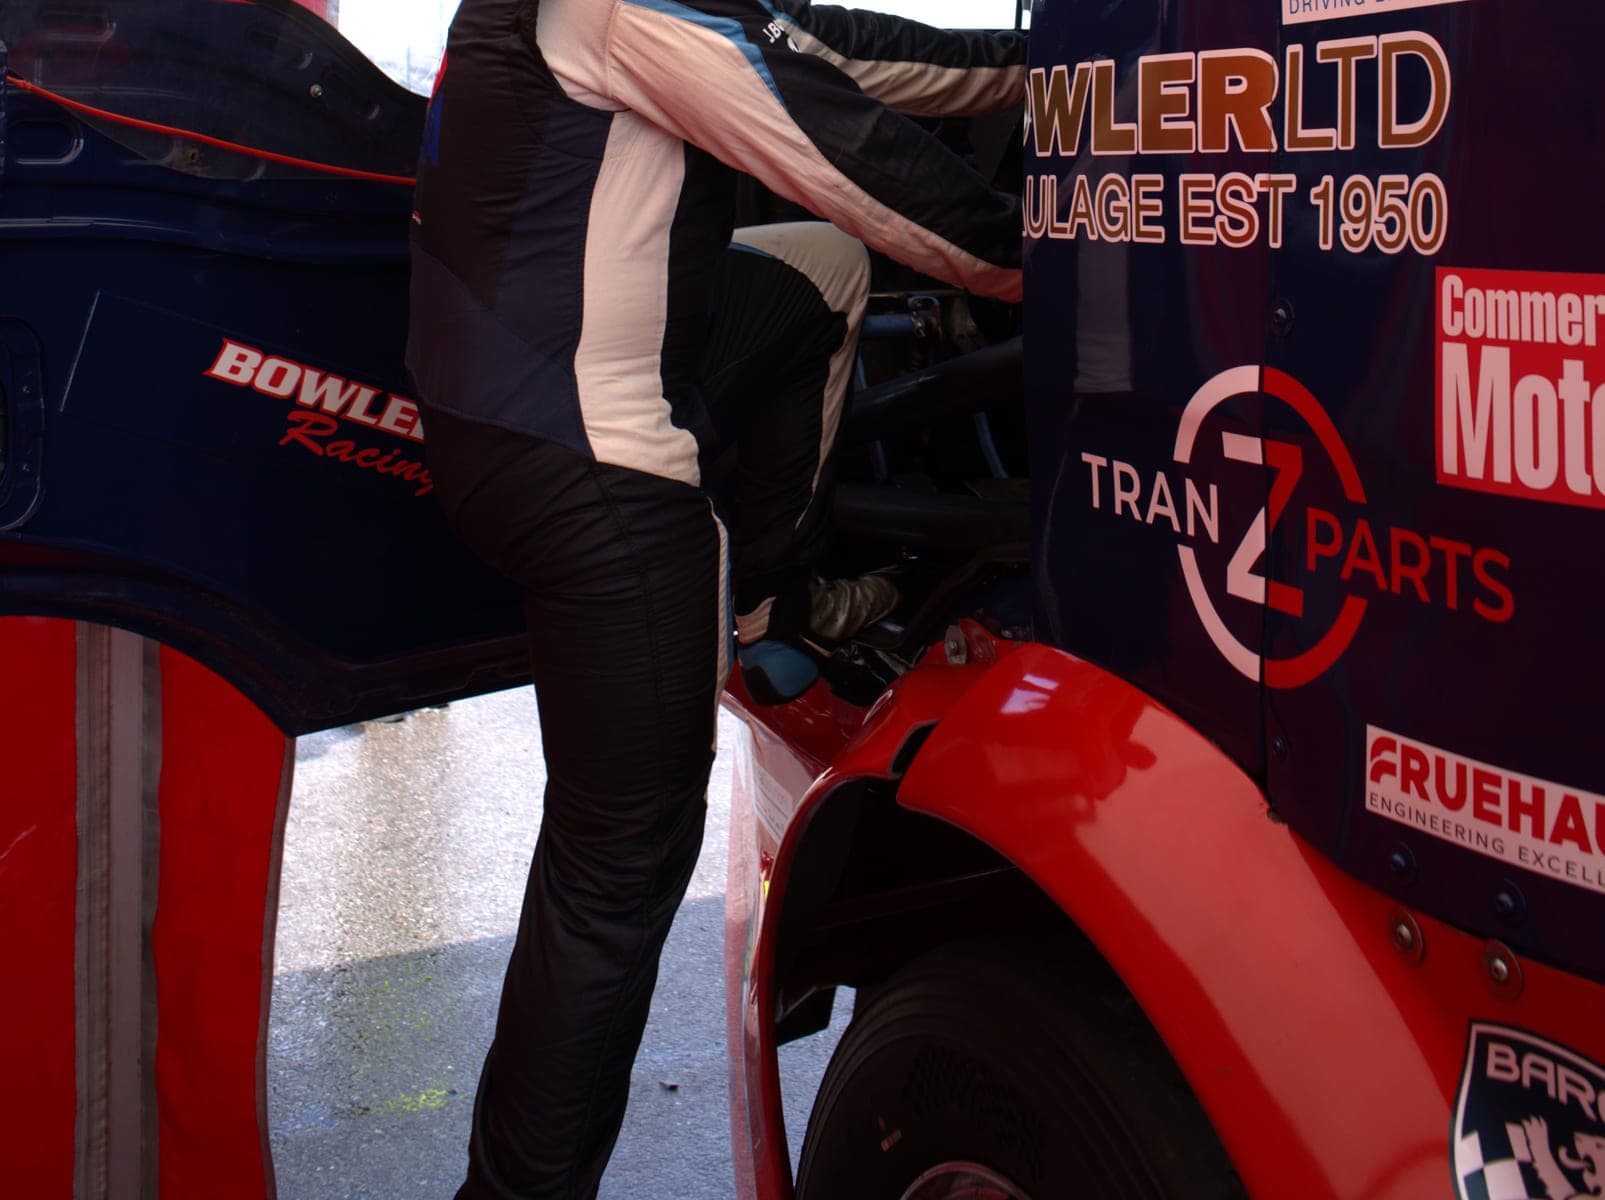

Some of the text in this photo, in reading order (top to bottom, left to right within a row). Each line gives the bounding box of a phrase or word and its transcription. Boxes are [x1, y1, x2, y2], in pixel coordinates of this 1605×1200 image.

[1023, 30, 1452, 157] WLER LTD
[1022, 171, 1449, 256] ULAGE EST 1950
[203, 337, 425, 444] BOWLE
[1369, 792, 1505, 856] ENGINEERING
[1486, 1041, 1605, 1122] BAR
